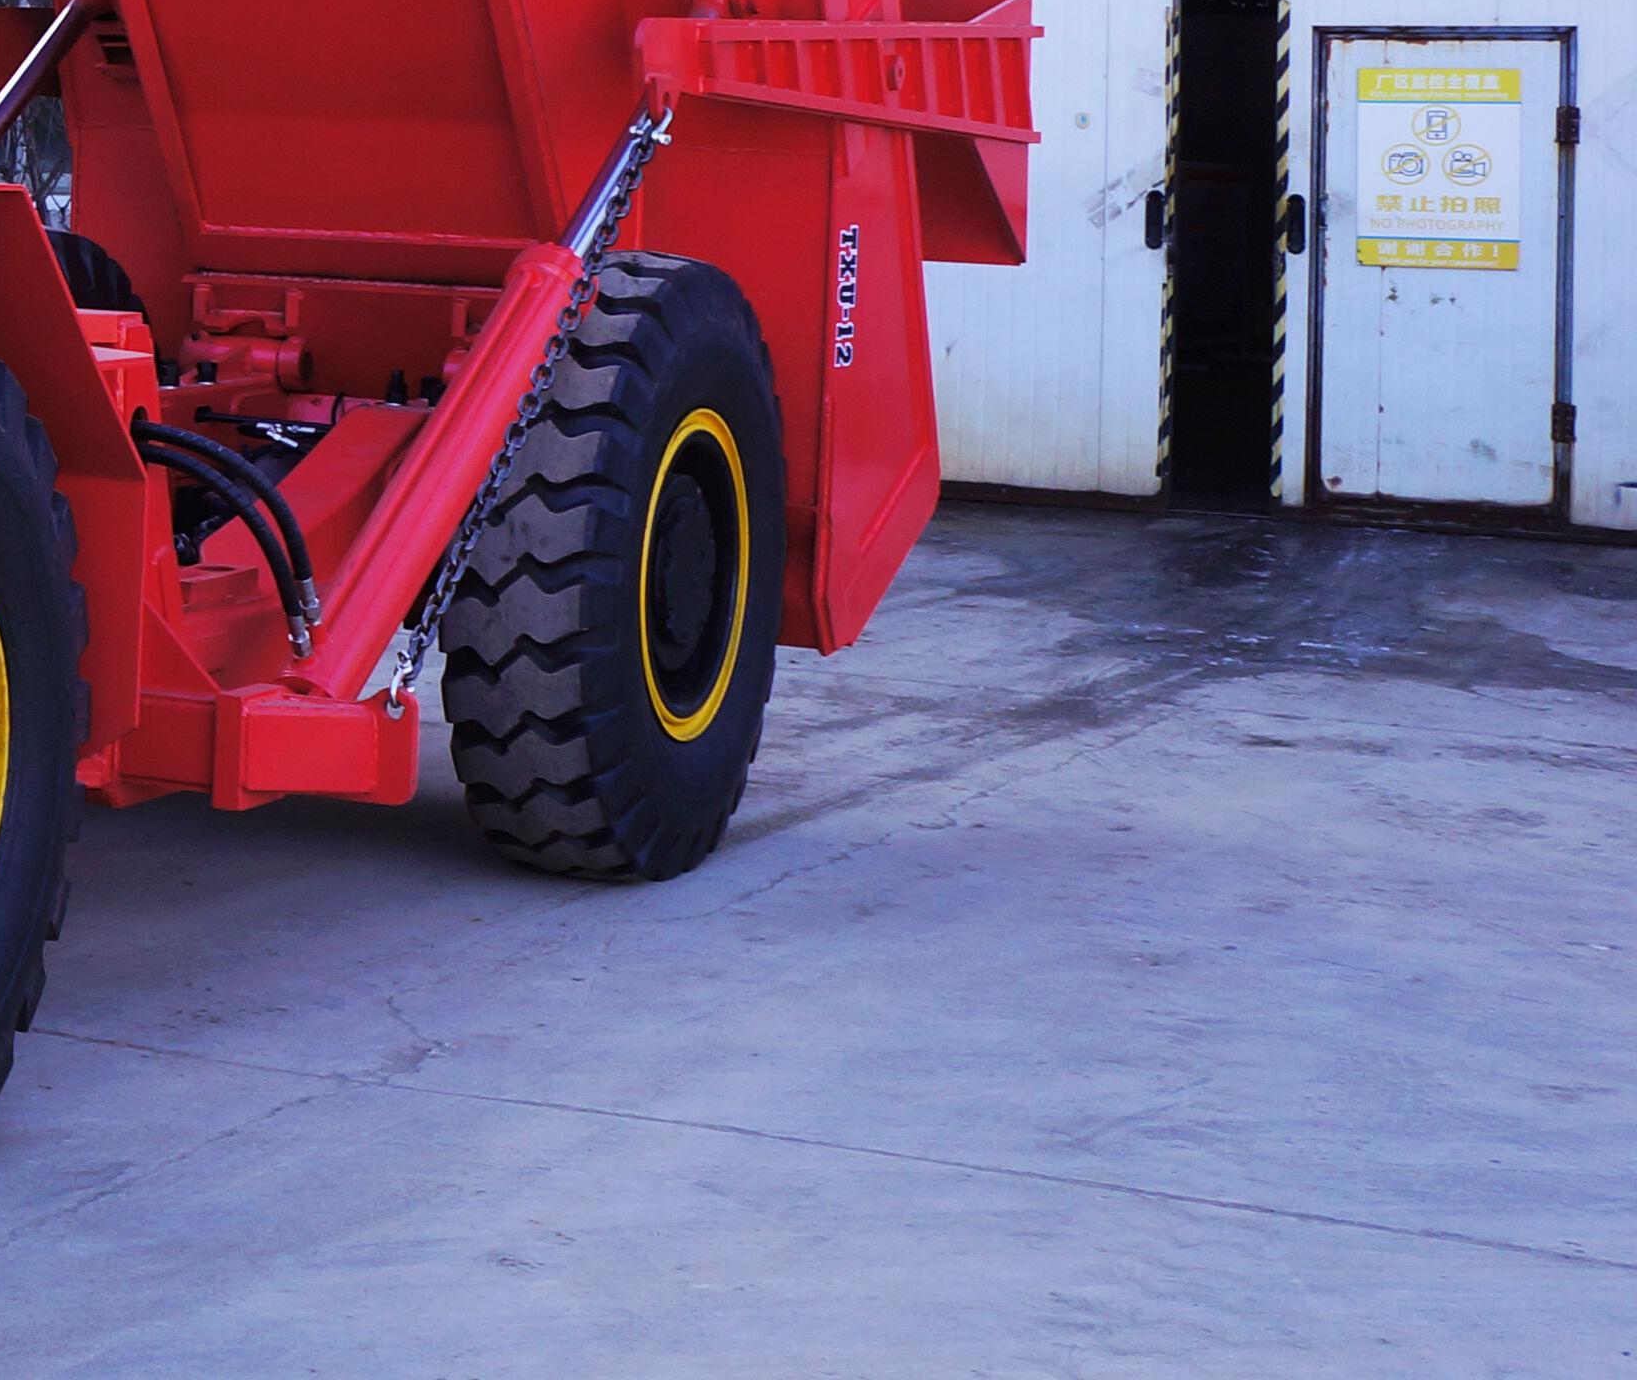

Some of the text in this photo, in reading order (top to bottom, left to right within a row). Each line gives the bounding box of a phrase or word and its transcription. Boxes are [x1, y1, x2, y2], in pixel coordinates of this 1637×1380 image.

[1375, 195, 1501, 214] 禁止拍照
[1370, 218, 1505, 231] NO PHOTOGRAPHY
[834, 224, 859, 368] TXU-12
